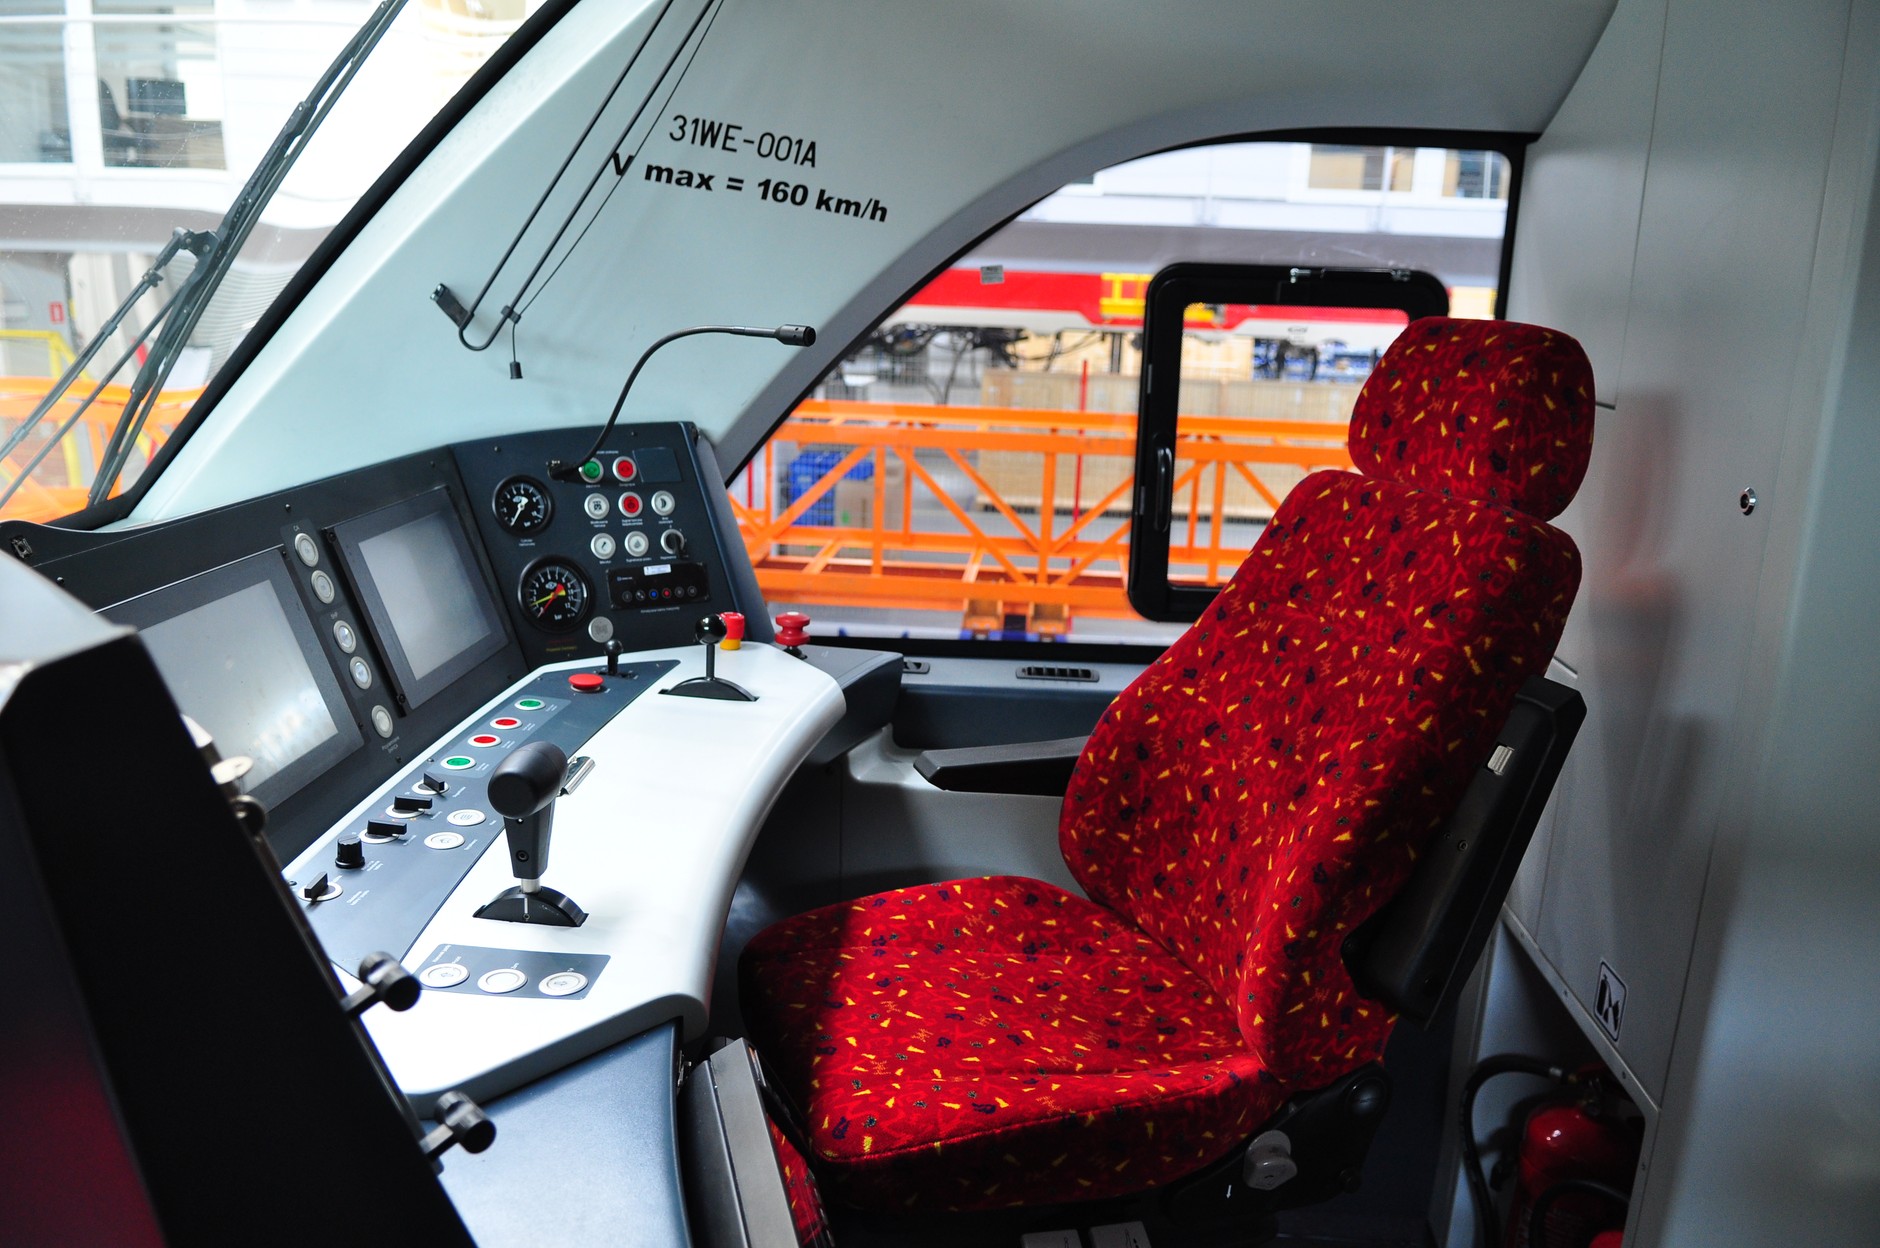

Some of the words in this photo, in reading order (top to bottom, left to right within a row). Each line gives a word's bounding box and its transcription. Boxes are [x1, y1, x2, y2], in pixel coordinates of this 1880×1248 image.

[669, 114, 817, 169] 31WE-001A
[612, 152, 634, 176] V
[644, 164, 715, 192] max
[726, 176, 745, 192] =
[757, 178, 809, 207] 160
[815, 188, 888, 223] km/h
